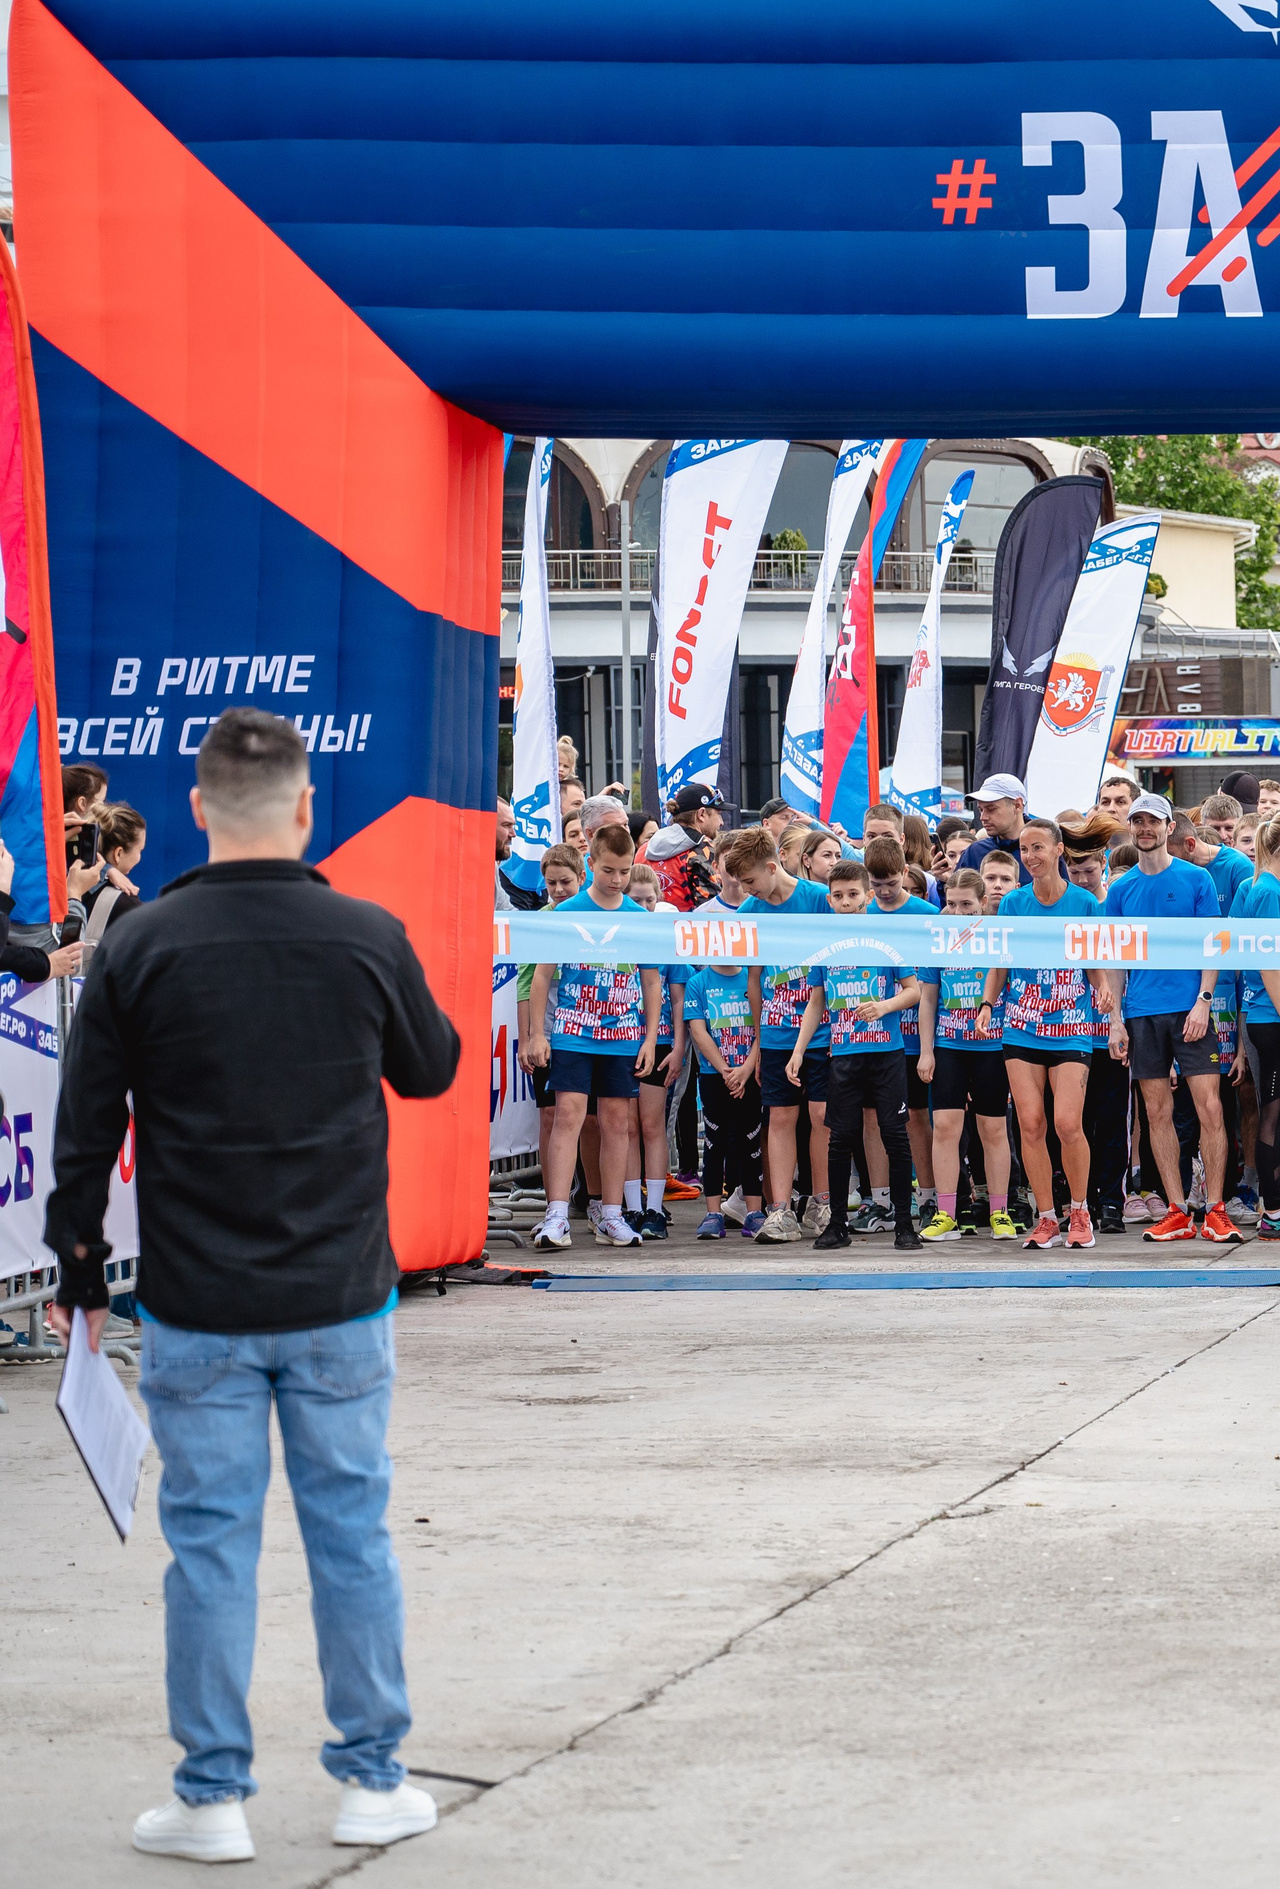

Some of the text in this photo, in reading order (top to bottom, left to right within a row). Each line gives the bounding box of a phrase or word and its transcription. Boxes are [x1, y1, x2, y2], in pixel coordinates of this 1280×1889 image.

[668, 501, 733, 720] FONT
[110, 655, 315, 695] В РИТМЕ
[674, 920, 759, 957] СТАРТ
[1065, 923, 1148, 961] СТАРТ
[836, 981, 868, 997] 10003
[952, 981, 982, 997] 10172
[720, 1000, 750, 1016] 10013
[1062, 1009, 1087, 1024] 2024
[552, 1020, 583, 1037] ЗАБЕГ
[849, 1031, 891, 1044] #ЕДИНСТВО
